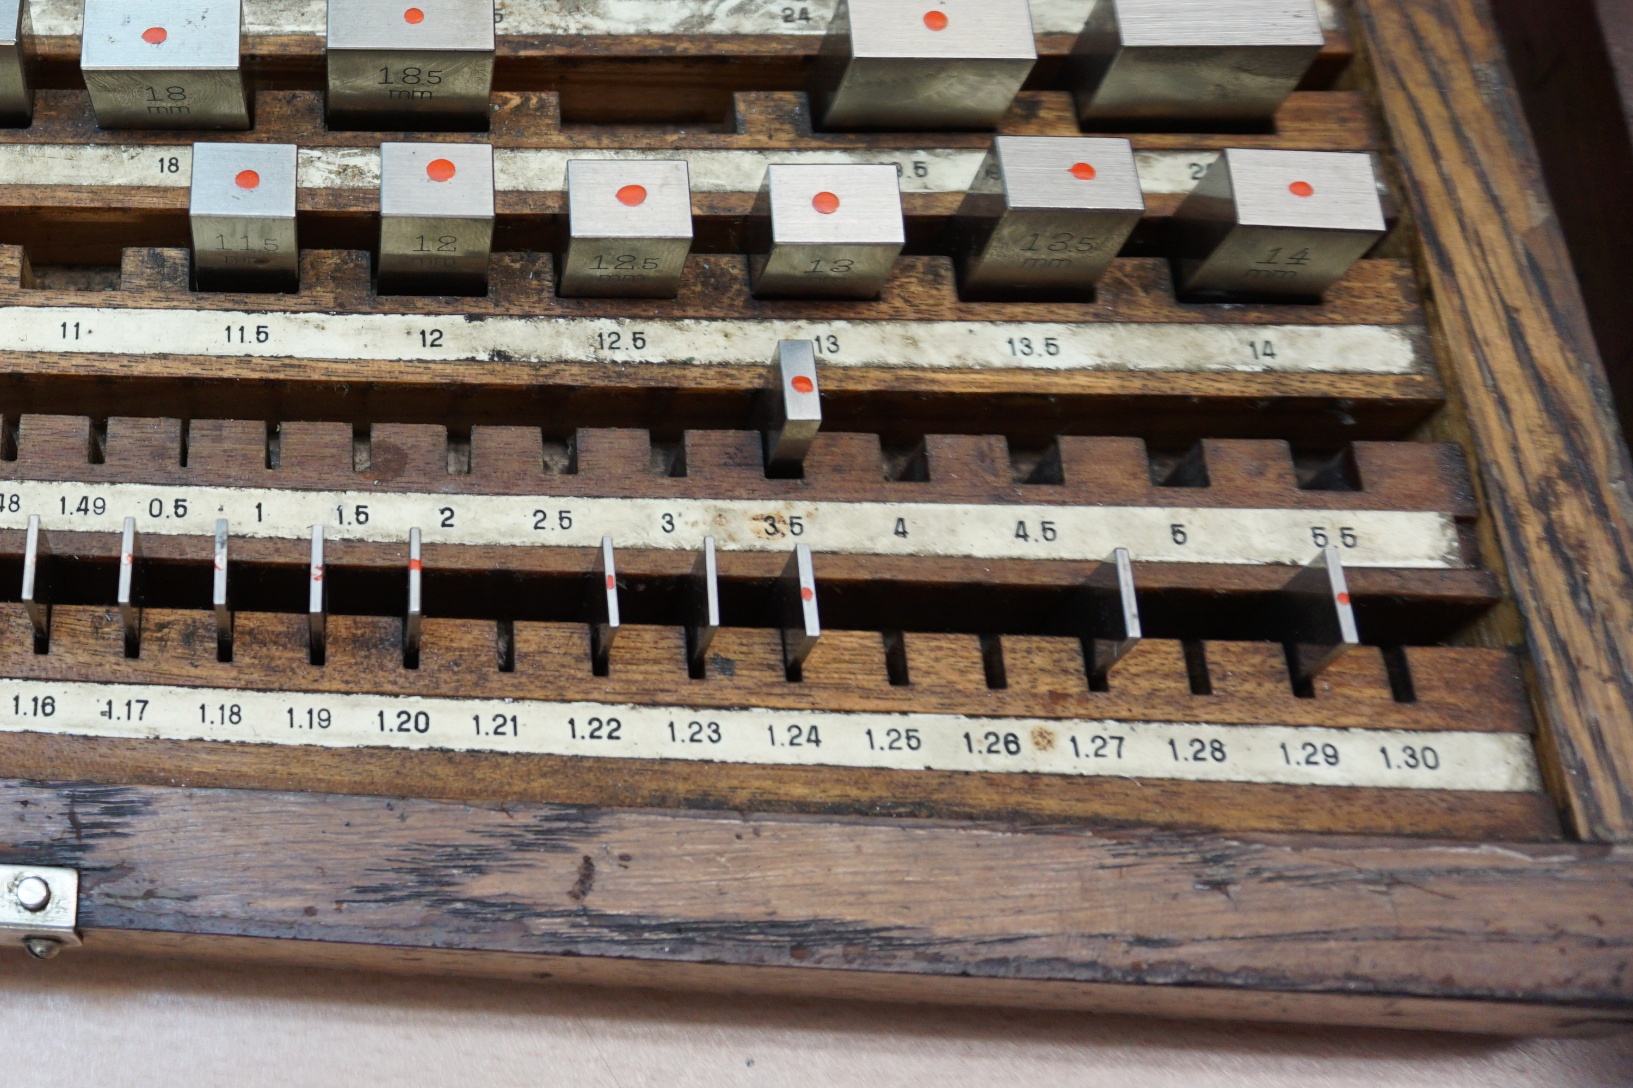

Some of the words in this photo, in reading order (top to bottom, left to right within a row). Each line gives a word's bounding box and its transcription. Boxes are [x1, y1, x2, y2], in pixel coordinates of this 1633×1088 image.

[780, 6, 814, 25] 24
[146, 85, 187, 102] 18
[388, 89, 433, 100] mm
[158, 156, 180, 174] 18
[412, 234, 458, 253] 12
[1255, 247, 1311, 265] 14
[803, 258, 854, 274] 13
[60, 321, 80, 341] 11
[224, 324, 269, 344] 11.5
[419, 328, 444, 348] 12
[597, 329, 646, 352] 12.5
[813, 332, 840, 355] 13
[1007, 336, 1060, 357] 13.5
[1247, 340, 1277, 361] 14
[59, 495, 107, 516] 1.49
[148, 497, 188, 519] 0.5
[255, 502, 263, 523] 1
[336, 504, 369, 526] 1.5
[438, 506, 455, 528] 2
[532, 509, 573, 531] 2.5
[661, 512, 675, 534] 3
[762, 513, 805, 539] 3.5
[893, 517, 910, 539] 4
[1014, 520, 1057, 543] 4.5
[1169, 523, 1188, 546] 5
[1310, 526, 1358, 549] 5.5
[12, 694, 56, 718] 1.16
[104, 697, 149, 722] 1.17
[199, 703, 242, 726] 1.18
[287, 707, 332, 730] 1.19
[377, 709, 430, 734] 1.20
[472, 713, 518, 737] 1.21
[567, 716, 622, 741] 1.22
[667, 720, 722, 744] 1.23
[767, 724, 822, 748] 1.24
[865, 728, 922, 751] 1.25
[963, 731, 1022, 756] 1.26
[1069, 734, 1126, 760] 1.27
[1167, 737, 1227, 763] 1.28
[1279, 741, 1340, 767] 1.29
[1379, 745, 1440, 771] 1.30
